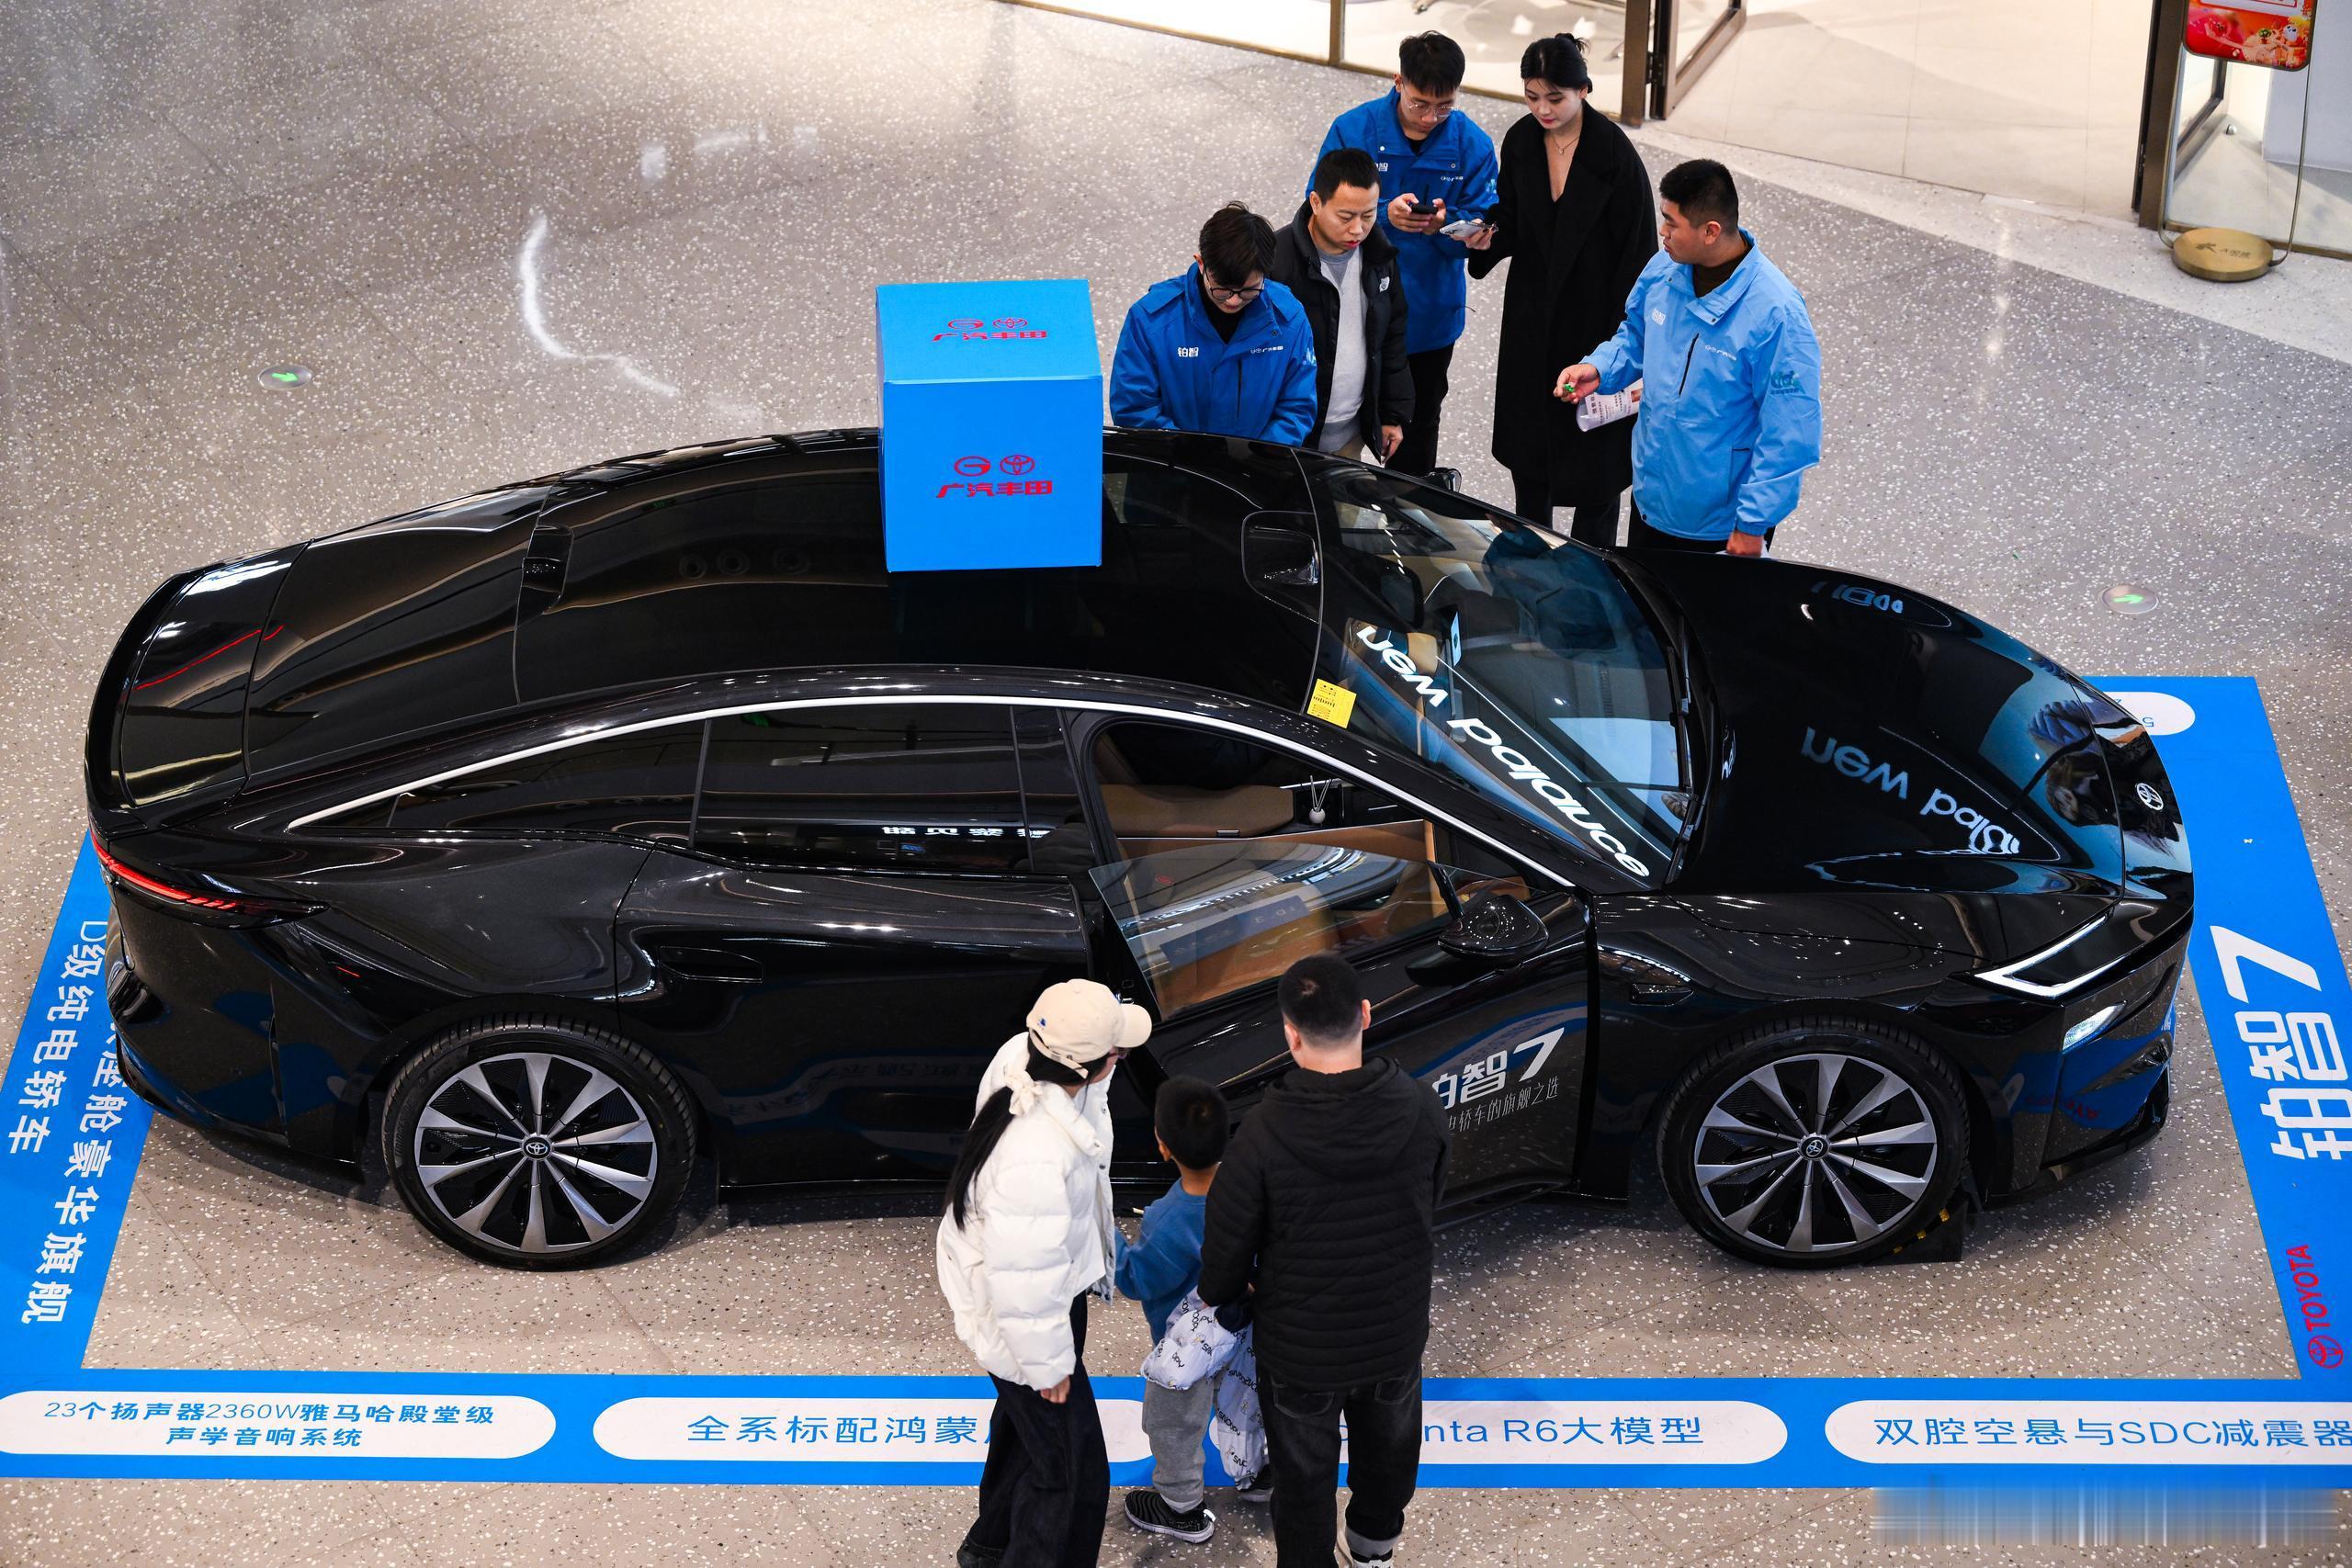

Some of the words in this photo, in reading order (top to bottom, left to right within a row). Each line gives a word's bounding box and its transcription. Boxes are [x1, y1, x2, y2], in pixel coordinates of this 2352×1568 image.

[931, 330, 1047, 342] 广汽丰田
[936, 479, 1053, 499] 广汽丰田
[21, 1021, 129, 1324] 座舱豪华旗舰
[2286, 1244, 2331, 1332] TOYOTA
[44, 1400, 495, 1426] 23个扬声器2360W雅马哈殿堂级
[165, 1426, 363, 1448] 声学音响系统
[687, 1414, 992, 1446] 全系标配鸿蒙
[1504, 1416, 1705, 1446] R6大模型
[1873, 1417, 2352, 1448] 双腔空悬与SDC减震器
